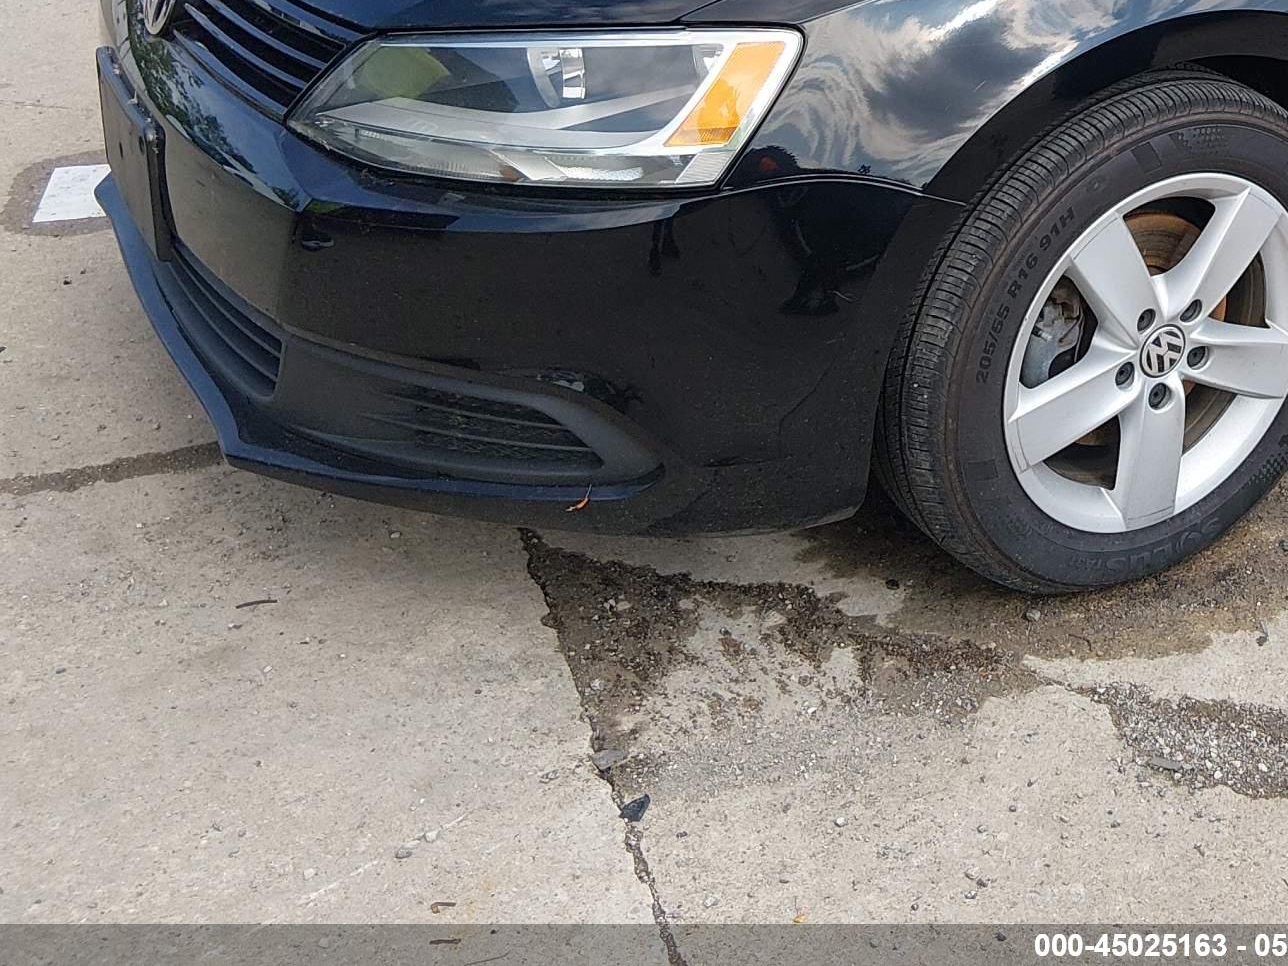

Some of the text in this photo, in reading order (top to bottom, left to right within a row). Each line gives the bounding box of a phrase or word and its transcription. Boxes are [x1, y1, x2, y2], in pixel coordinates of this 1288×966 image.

[975, 206, 1075, 384] 205/55 R16 91H
